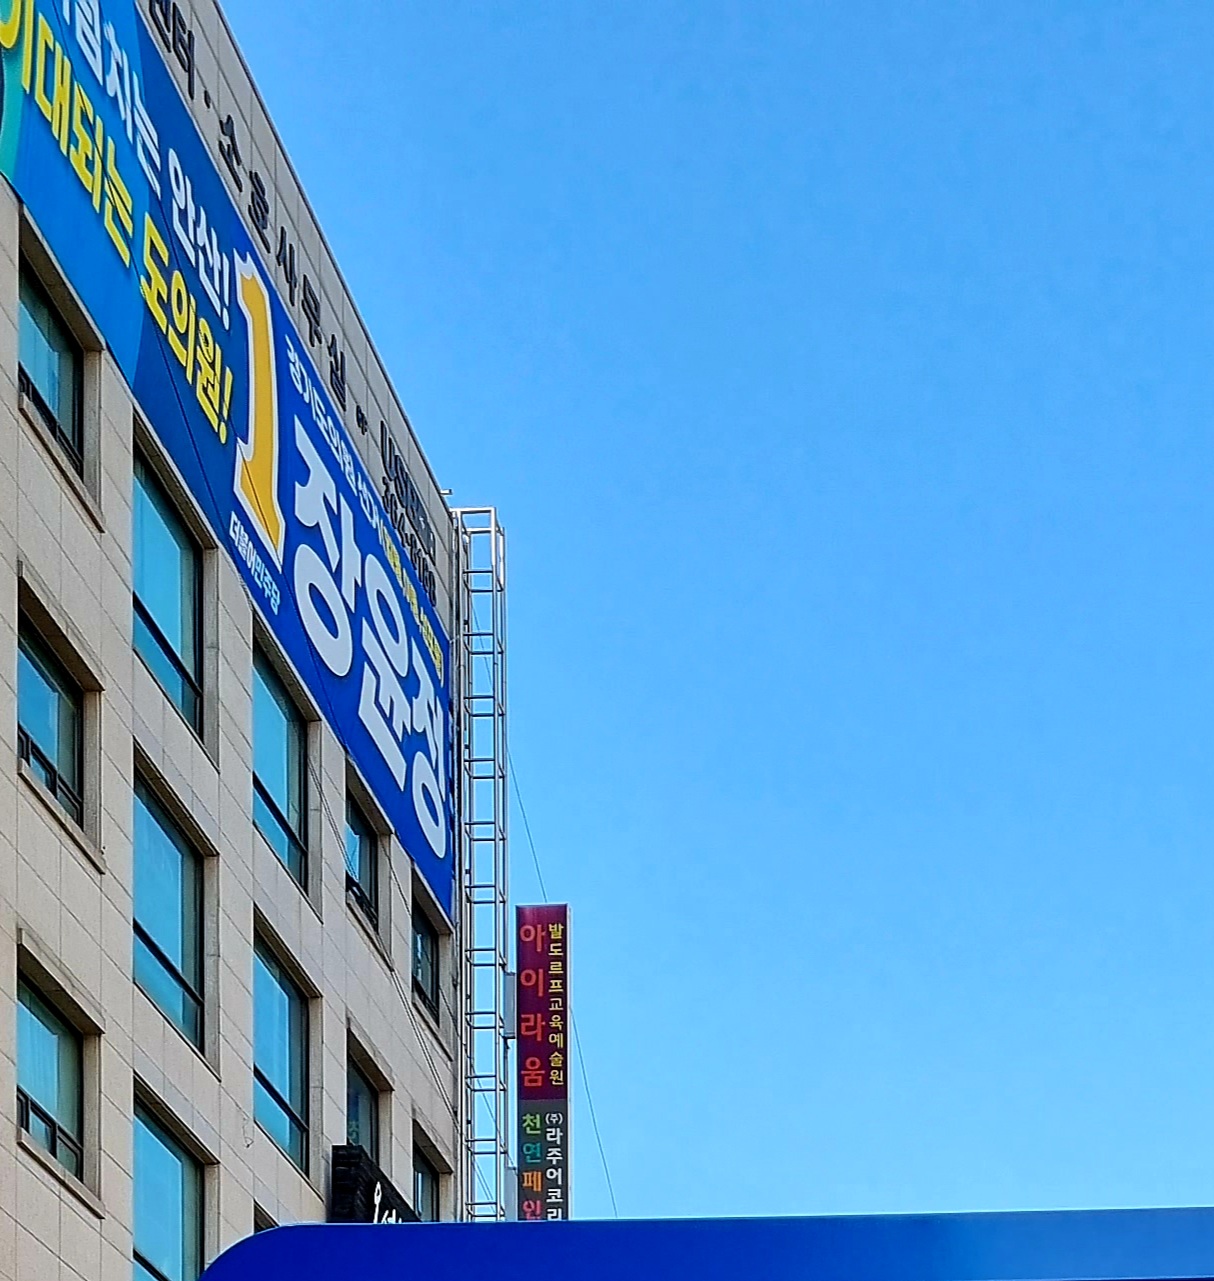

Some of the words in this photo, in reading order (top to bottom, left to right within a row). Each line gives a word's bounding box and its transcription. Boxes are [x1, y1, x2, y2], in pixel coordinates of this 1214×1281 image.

[140, 210, 234, 445] 도의원!
[293, 413, 448, 860] 장윤정
[519, 923, 546, 1088] 아이라움
[547, 922, 565, 1086] 발도르프교육예술원
